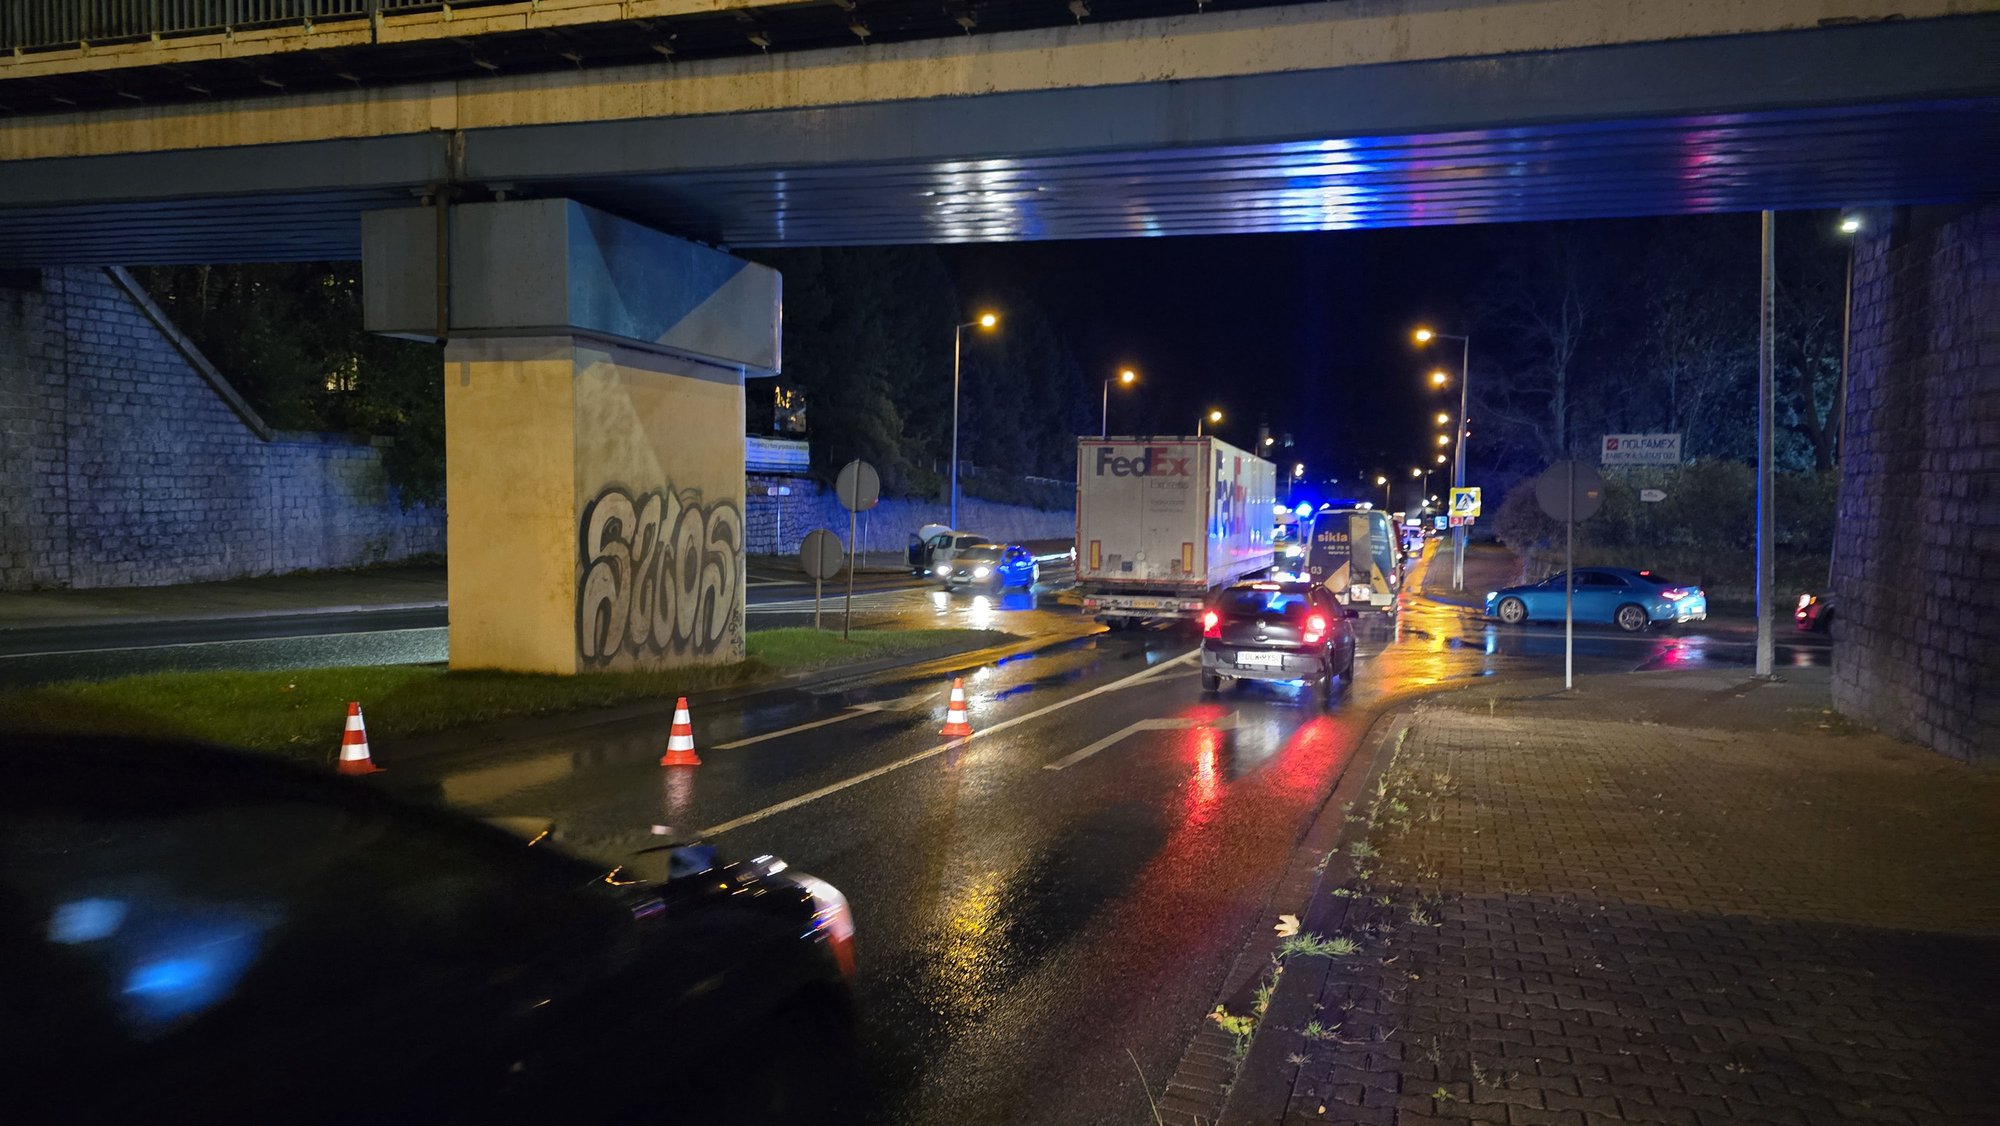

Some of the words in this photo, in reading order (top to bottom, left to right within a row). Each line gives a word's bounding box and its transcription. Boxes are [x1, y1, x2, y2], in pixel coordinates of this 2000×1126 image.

[1096, 447, 1190, 477] FedEx
[1317, 530, 1348, 542] sikla
[1310, 566, 1322, 575] 03
